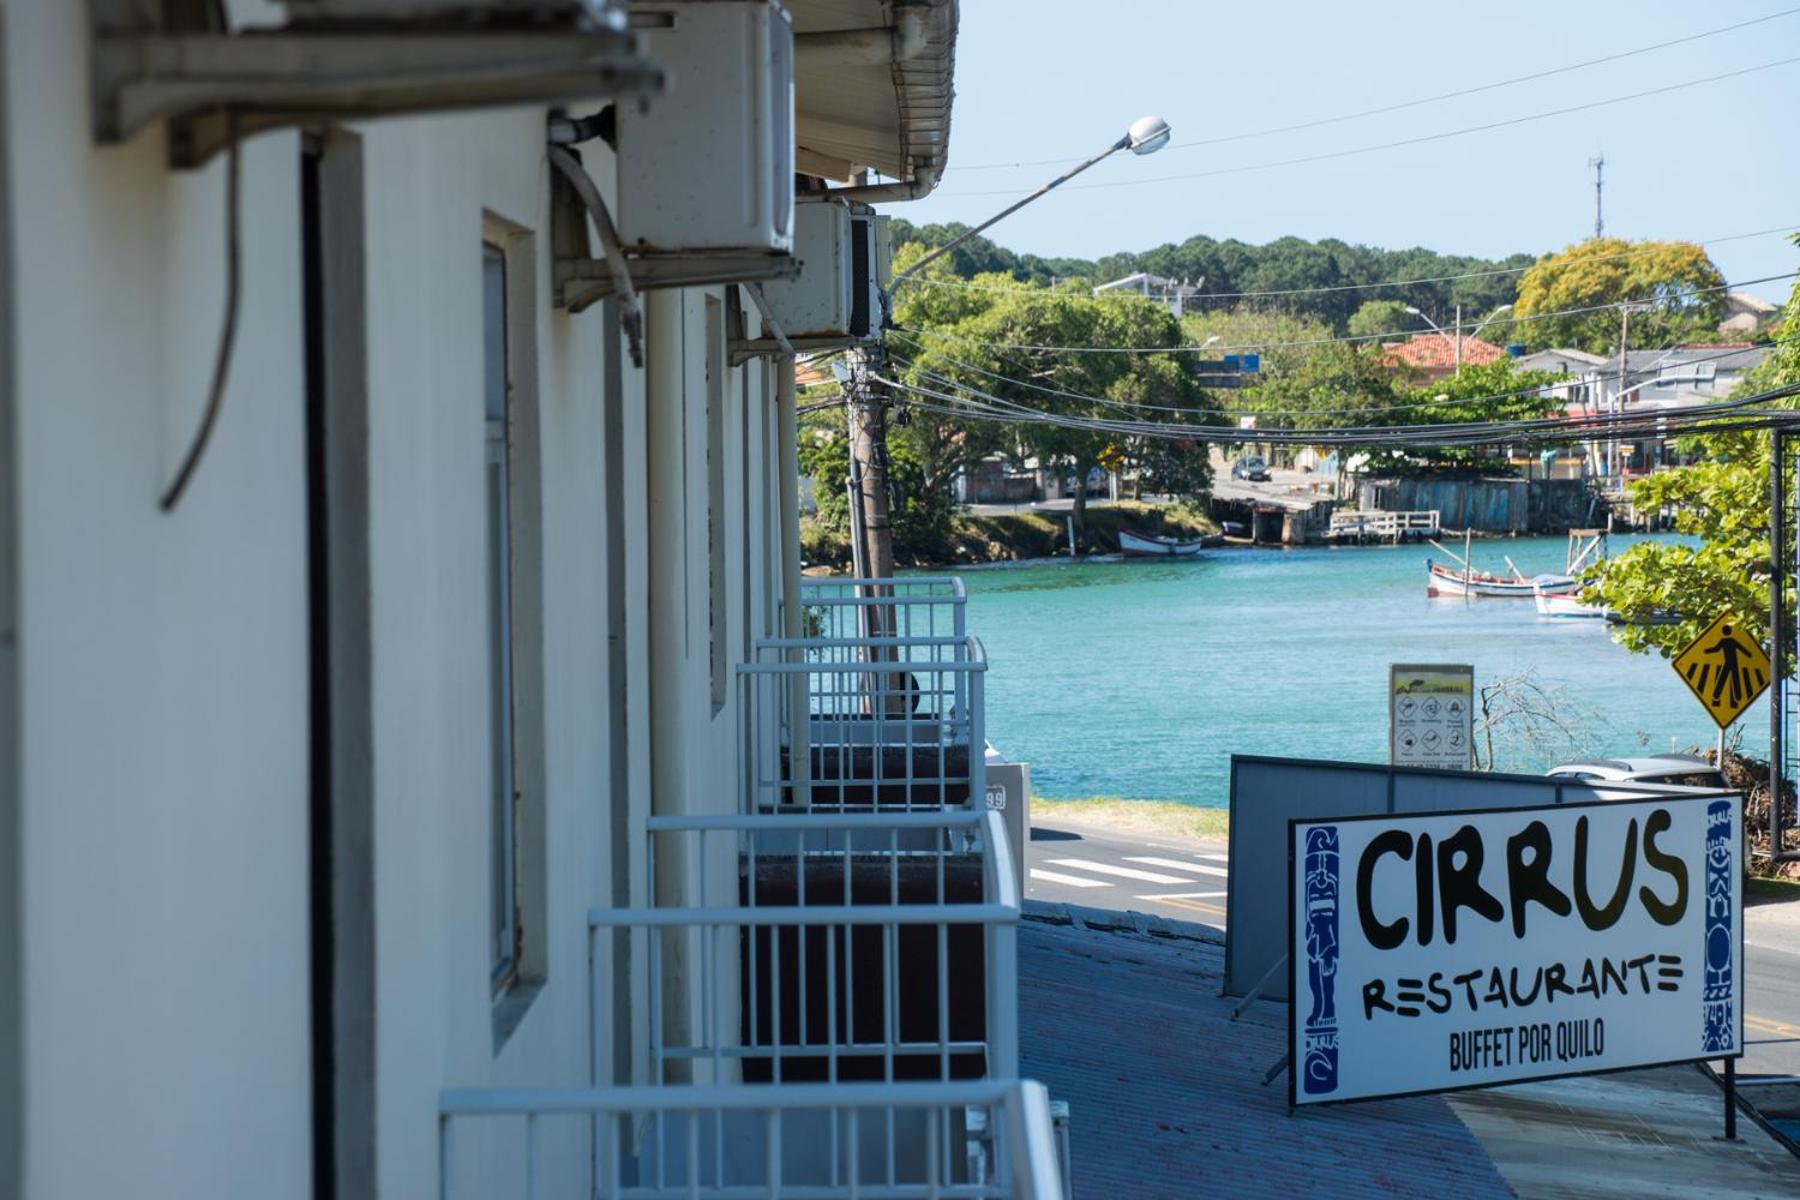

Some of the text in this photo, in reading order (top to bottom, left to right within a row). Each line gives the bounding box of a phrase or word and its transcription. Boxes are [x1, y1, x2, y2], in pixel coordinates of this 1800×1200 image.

[1356, 808, 1689, 951] CIRRUS
[1362, 953, 1684, 1021] RESTAURANTE
[1449, 1017, 1604, 1072] BUFFET POR QUILO
